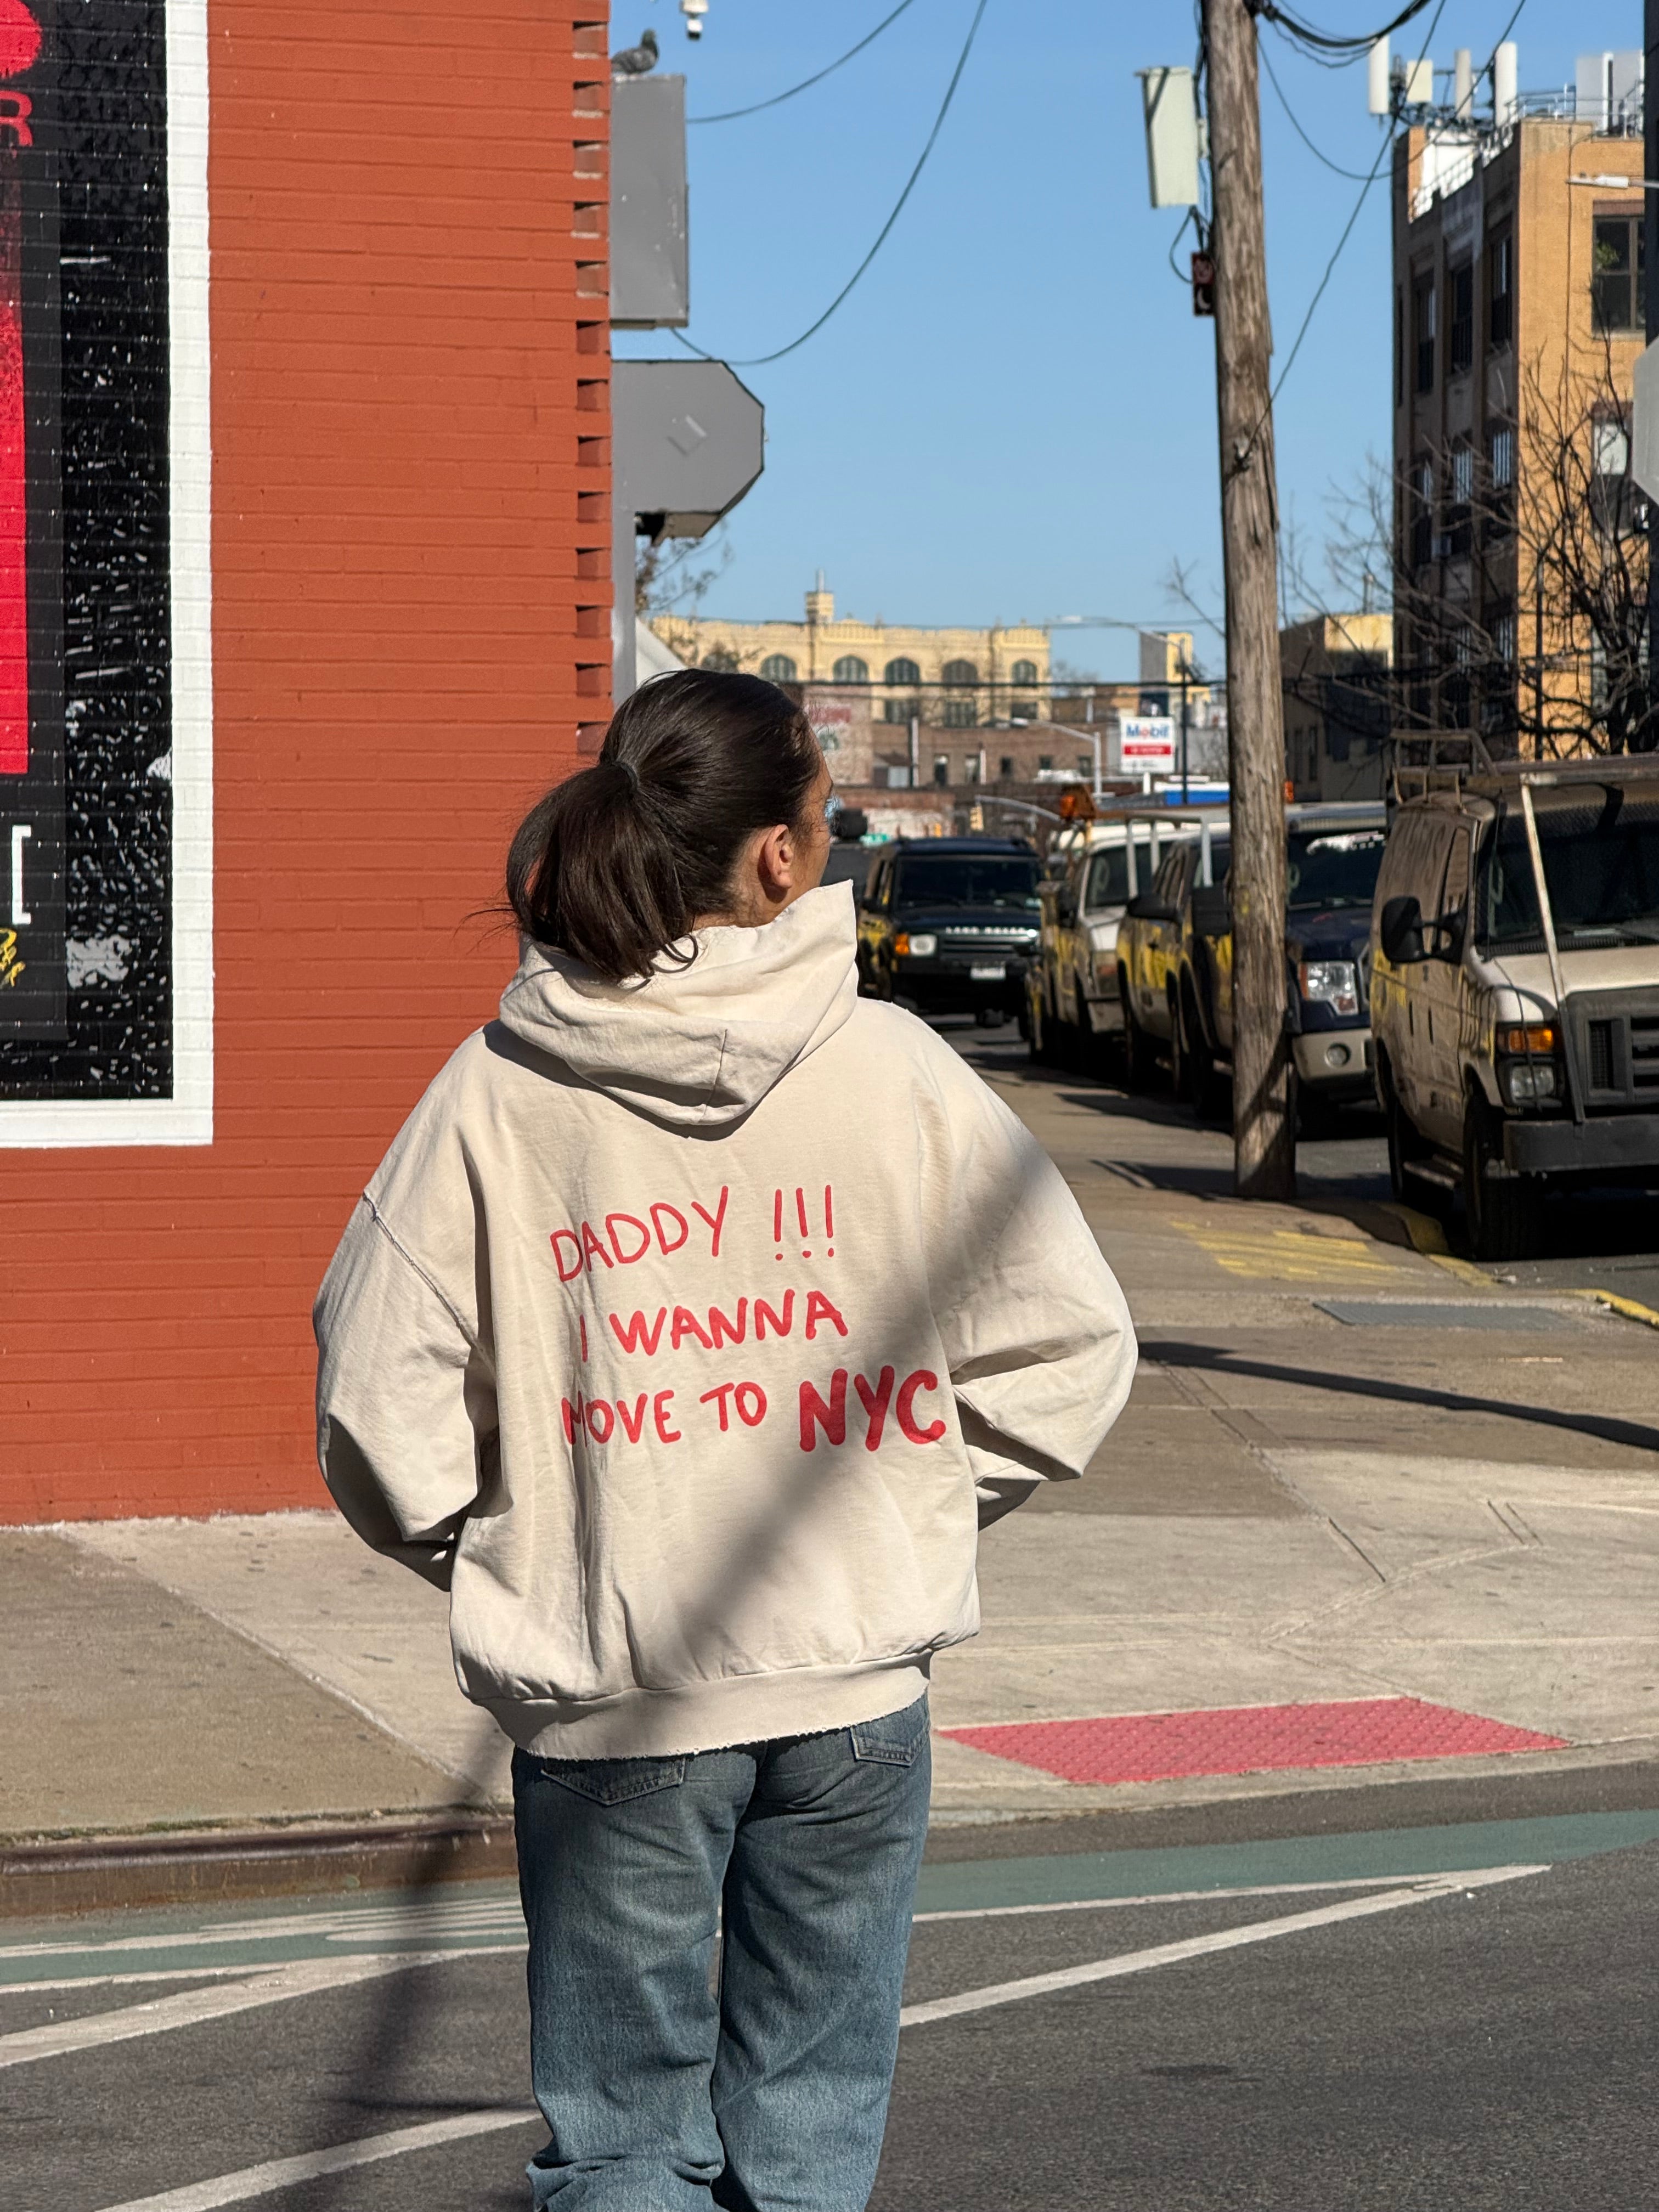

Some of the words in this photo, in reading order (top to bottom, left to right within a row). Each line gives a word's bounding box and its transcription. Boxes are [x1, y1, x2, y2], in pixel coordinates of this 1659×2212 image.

[550, 1185, 729, 1282] DADDY
[579, 1314, 588, 1362] I
[608, 1288, 848, 1356] WANNA
[561, 1390, 681, 1448] MOVE
[699, 1381, 768, 1431] TO
[799, 1365, 946, 1452] NYC
